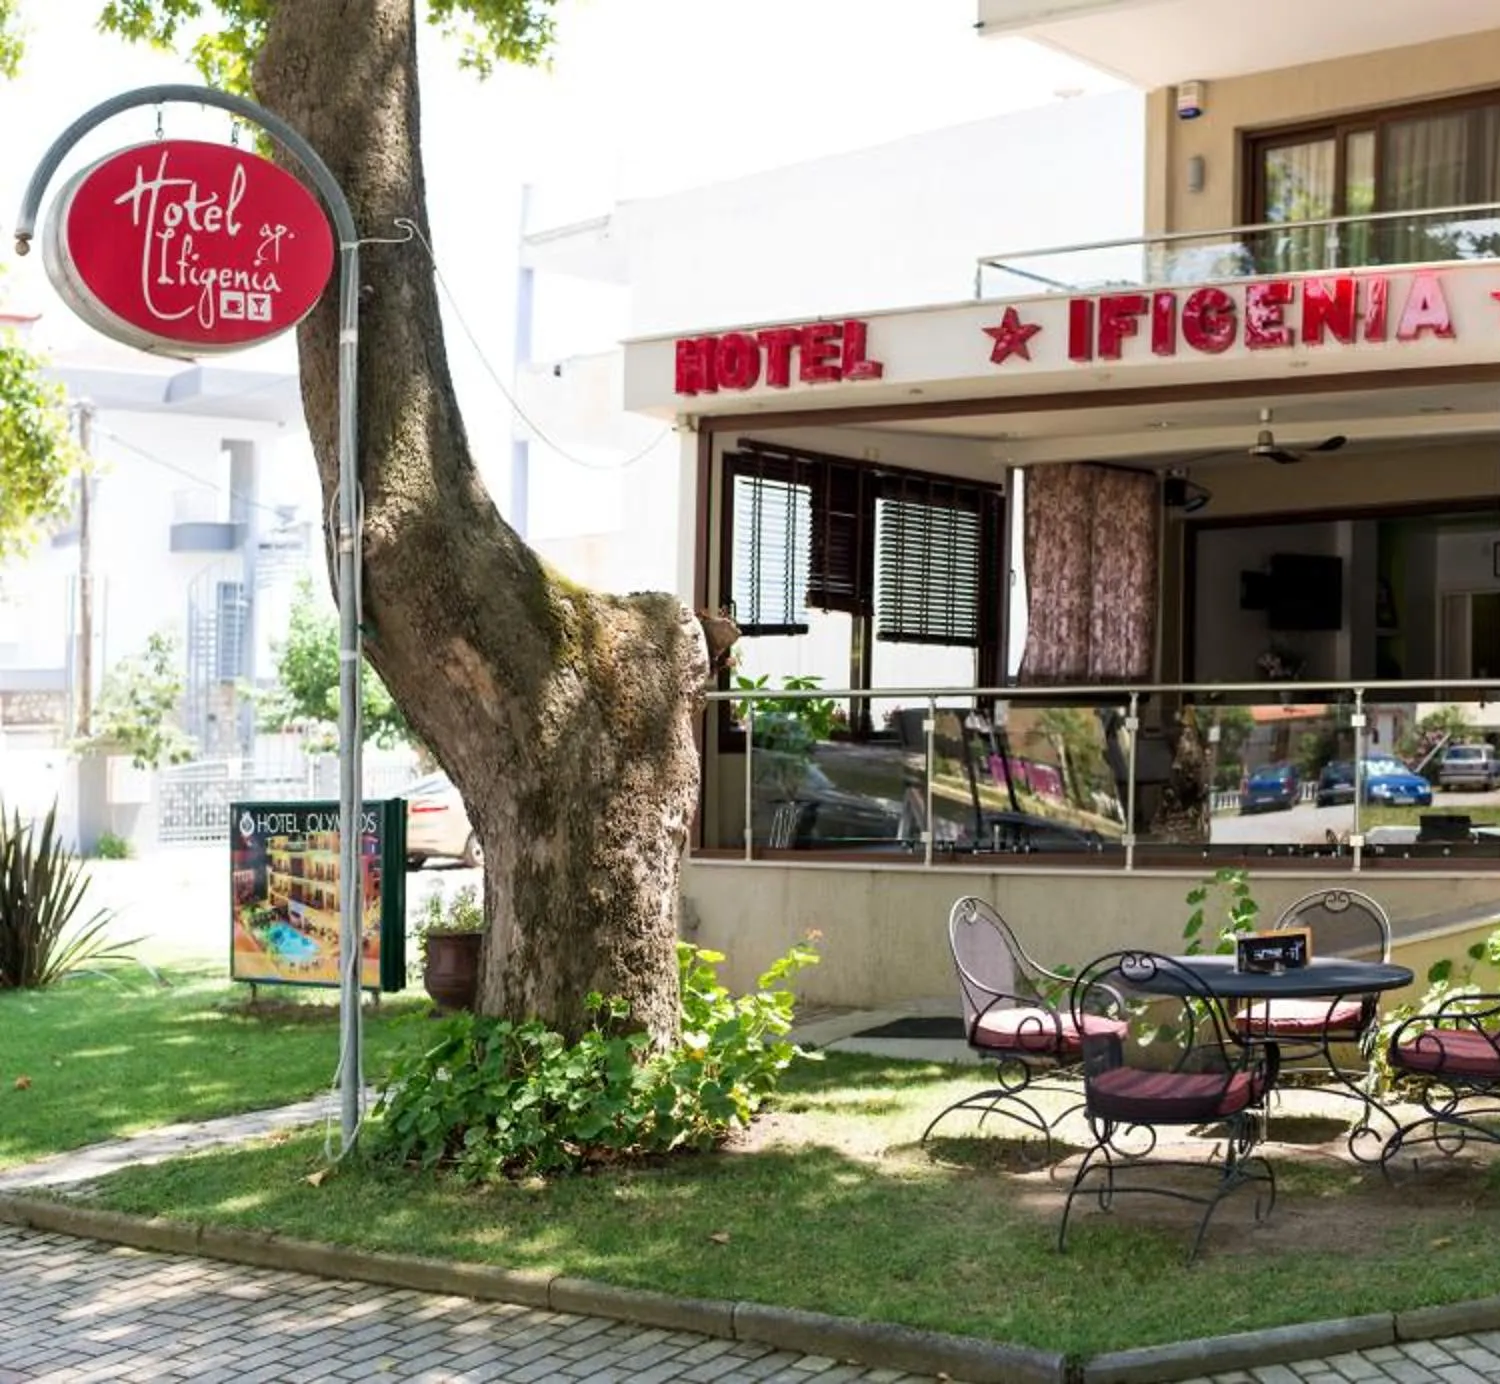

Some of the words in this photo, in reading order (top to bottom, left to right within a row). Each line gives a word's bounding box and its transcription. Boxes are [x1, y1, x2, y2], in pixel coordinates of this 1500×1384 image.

[115, 151, 246, 320] Hotel
[156, 227, 281, 329] Ifigenia
[675, 319, 883, 396] HOTEL
[1068, 272, 1456, 362] IFIGENIA
[257, 812, 300, 833] HOTEL
[306, 811, 377, 833] OLYOS
